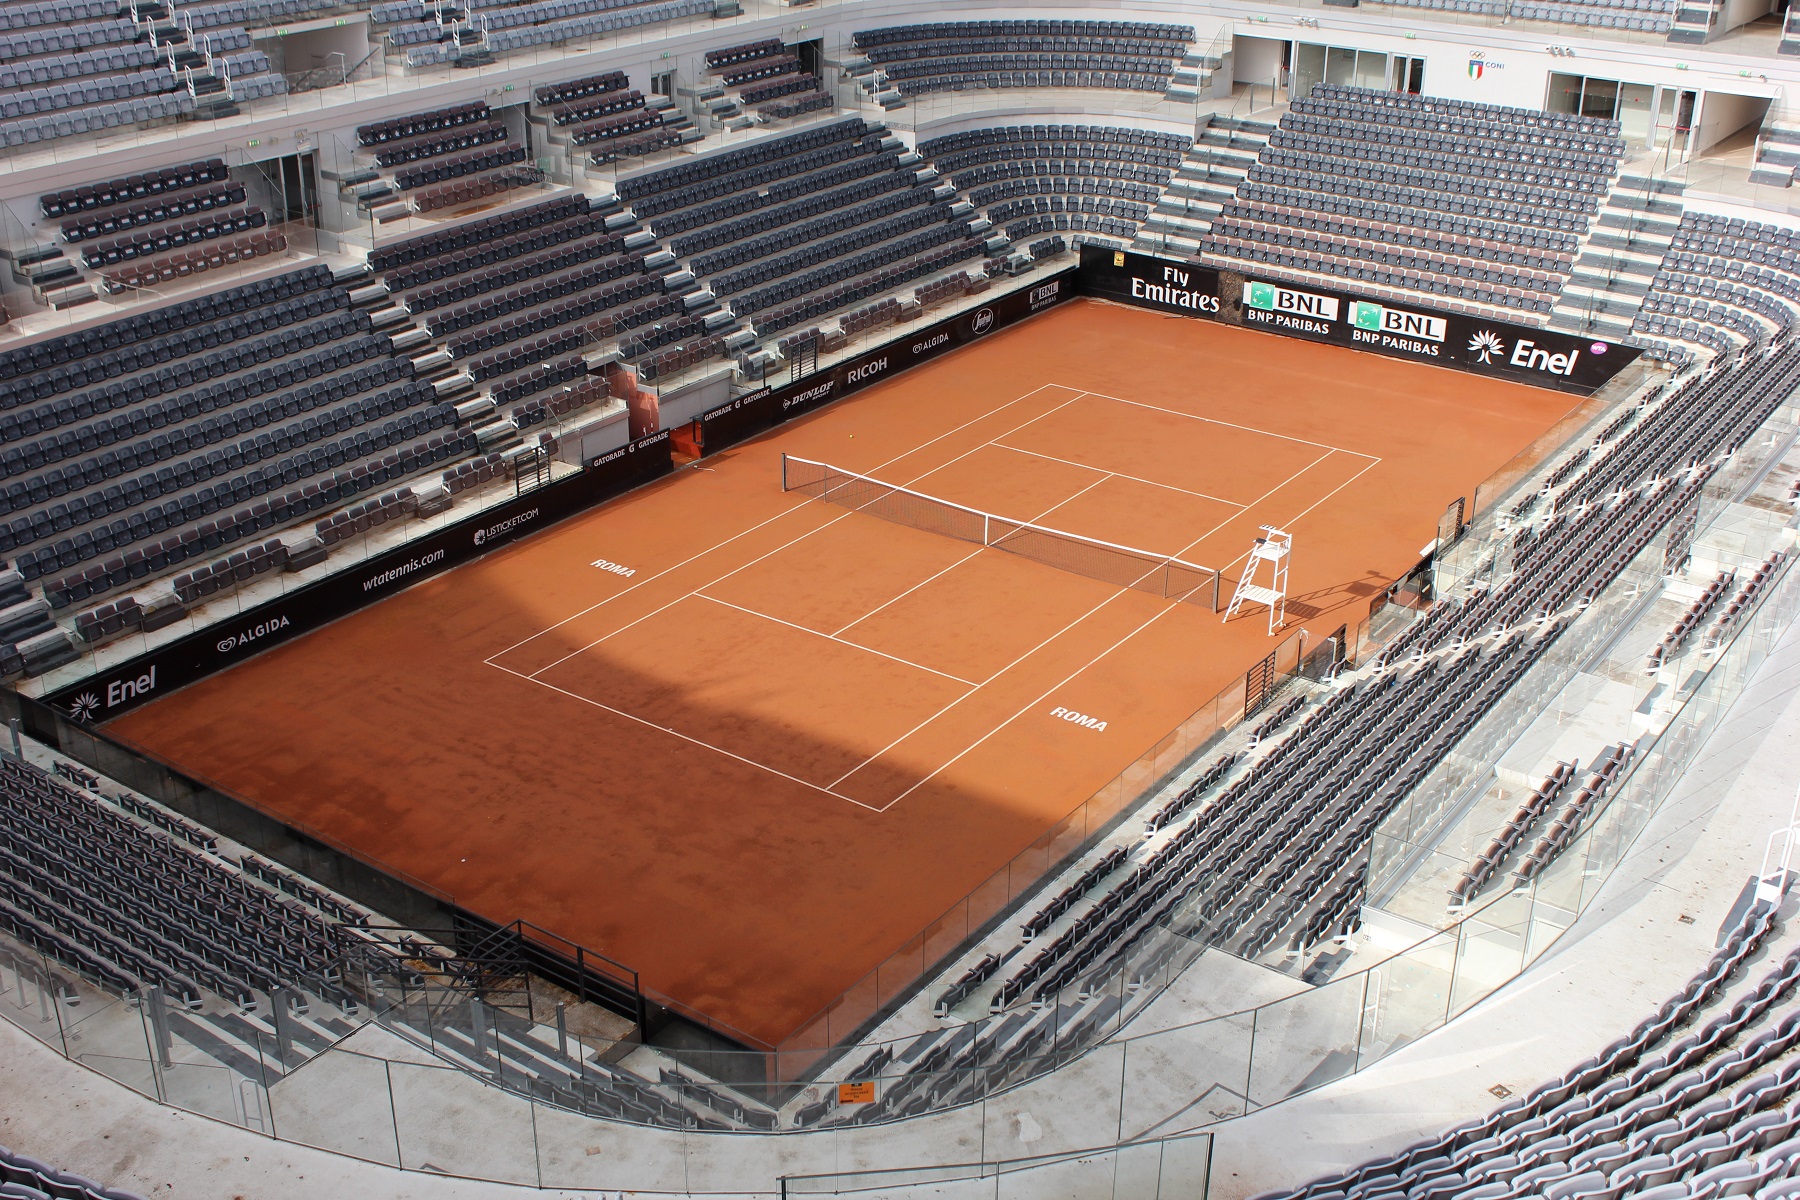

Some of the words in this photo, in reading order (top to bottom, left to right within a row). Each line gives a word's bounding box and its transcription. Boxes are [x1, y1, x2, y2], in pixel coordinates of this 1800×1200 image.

[1163, 266, 1189, 287] Fly
[1039, 283, 1057, 298] BNL
[1131, 276, 1220, 313] Emirates
[1277, 290, 1330, 317] BNL
[1247, 309, 1274, 323] BNP
[1275, 314, 1330, 335] PARIBAS
[1384, 311, 1440, 338] BNL
[923, 332, 949, 351] ALGIDA
[1352, 329, 1380, 344] BNP
[1382, 335, 1439, 356] PARIBAS
[847, 356, 888, 384] RICOH
[1509, 338, 1580, 376] Enel
[704, 404, 732, 422] GATORADE
[743, 388, 770, 405] GATORADE
[791, 380, 835, 406] DUNLOP
[593, 449, 626, 467] GATORADE
[638, 431, 669, 449] GATORADE
[486, 507, 539, 537] LISTICKET.COM
[363, 548, 444, 592] wtatennis.com
[589, 558, 636, 578] ROMA
[238, 615, 290, 646] ALGIDA
[107, 665, 156, 708] Enel
[1049, 706, 1108, 732] ROMA
